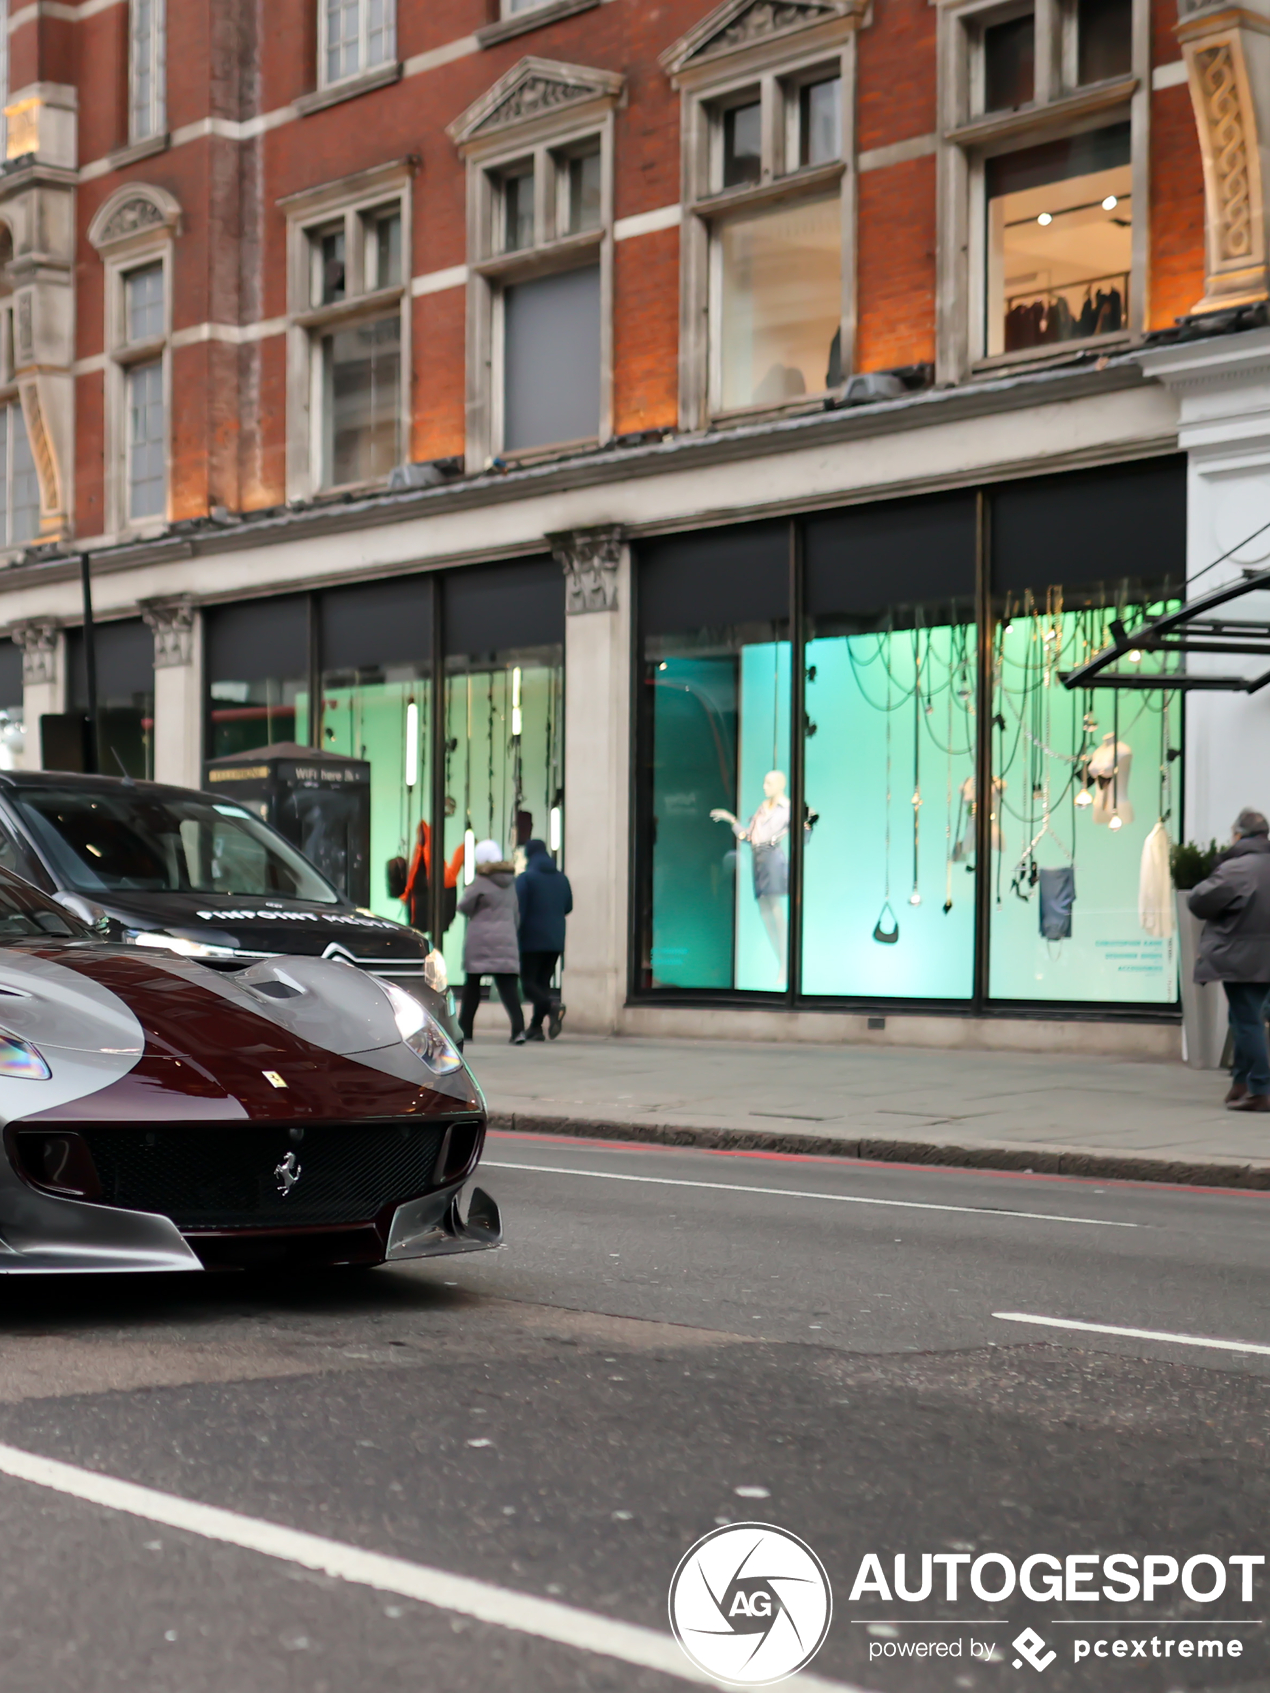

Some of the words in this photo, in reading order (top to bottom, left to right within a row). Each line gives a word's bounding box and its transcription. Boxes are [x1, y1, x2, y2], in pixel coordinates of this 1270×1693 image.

[321, 769, 342, 782] here
[196, 910, 319, 921] PINPOINT
[322, 914, 400, 930] MEDIA
